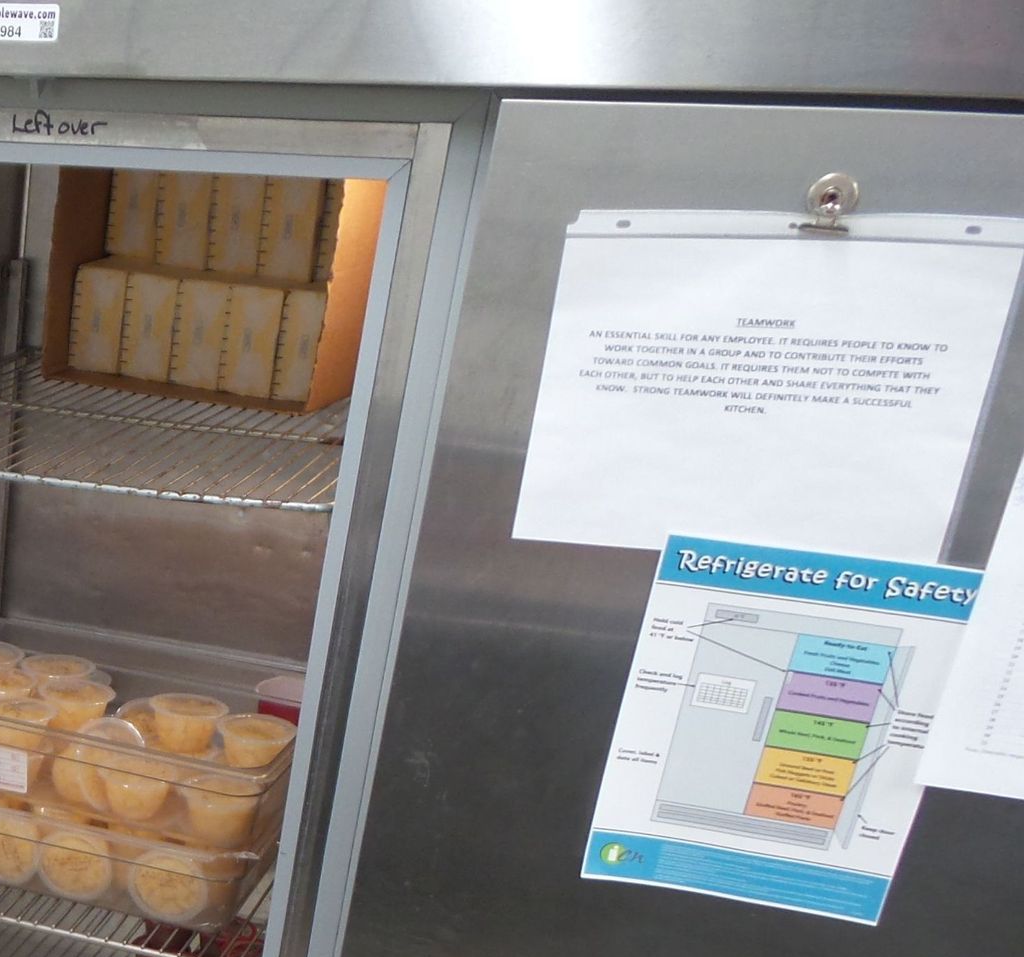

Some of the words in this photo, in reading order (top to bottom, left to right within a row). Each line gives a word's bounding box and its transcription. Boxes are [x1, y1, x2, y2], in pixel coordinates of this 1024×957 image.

[737, 318, 795, 328] TEAMWORK
[589, 330, 602, 338] AN
[605, 331, 651, 340] ESSENTIAL
[655, 332, 677, 341] SKILL
[680, 334, 699, 342] FOR
[701, 335, 720, 343] ANY
[723, 336, 774, 345] EMPLOYEE.
[778, 337, 788, 345] IT
[791, 338, 838, 347] REQUIRES
[841, 340, 876, 349] PEOPLE
[880, 342, 894, 350] TO
[897, 343, 930, 351] KNOW
[934, 344, 948, 352] TO
[604, 344, 633, 352] WORK
[636, 345, 684, 355] TOGETHER
[687, 347, 697, 355] IN
[708, 349, 741, 357] GROUP
[744, 350, 765, 358] AND
[769, 351, 781, 359] TO
[784, 351, 846, 362] CONTRIBUTE
[850, 354, 877, 363] THEIR
[880, 356, 924, 365] EFFORTS
[593, 357, 633, 366] TOWARD
[636, 359, 682, 368] COMMON
[685, 361, 717, 370] GOALS.
[720, 362, 729, 370] IT
[732, 363, 778, 373] REQUIRES
[782, 365, 810, 374] THEM
[813, 367, 833, 375] NOT
[837, 368, 849, 376] TO
[852, 369, 899, 379] COMPETE
[903, 371, 931, 380] WITH
[579, 369, 602, 378] EACH
[605, 371, 637, 380] OTHER,
[640, 372, 659, 380] BUT
[662, 373, 673, 381] TO
[677, 374, 699, 383] HELP
[701, 376, 725, 384] EACH
[727, 377, 759, 386] OTHER
[762, 379, 783, 387] AND
[786, 380, 817, 388] SHARE
[820, 381, 881, 392] EVERYTHING
[884, 385, 911, 393] THAT
[914, 386, 940, 394] THEY
[596, 384, 627, 393] KNOW.
[633, 386, 670, 395] STRONG
[673, 388, 727, 398] TEAMWORK
[731, 391, 752, 400] WILL
[755, 392, 808, 402] DEFINITELY
[812, 396, 840, 404] MAKE
[844, 396, 851, 404] A
[853, 397, 912, 408] SUCCESSFUL
[724, 405, 766, 414] KITCHEN.
[678, 549, 828, 586] Refrigerate
[835, 570, 879, 590] for
[885, 576, 978, 605] Safety
